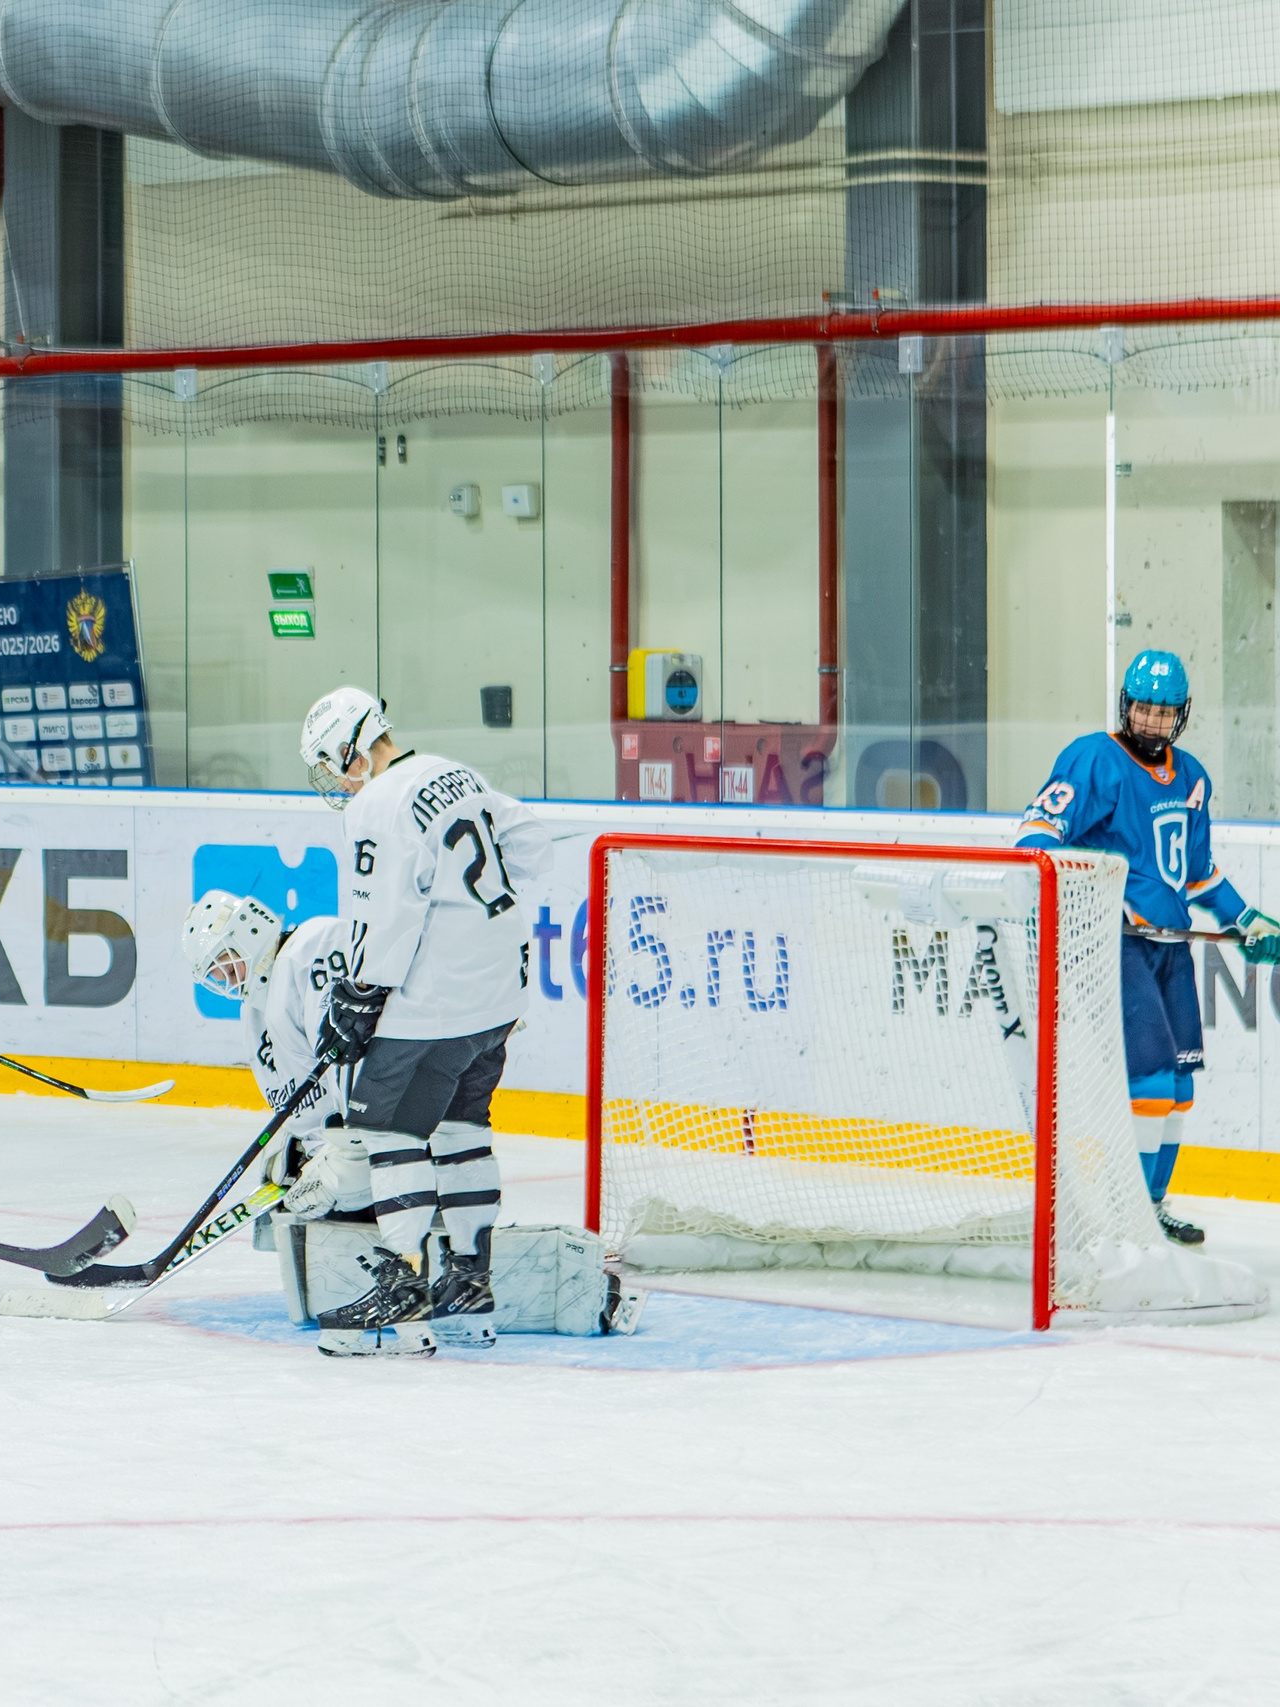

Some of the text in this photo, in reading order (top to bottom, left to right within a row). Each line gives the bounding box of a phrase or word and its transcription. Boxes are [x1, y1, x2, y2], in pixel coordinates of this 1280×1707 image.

[273, 612, 308, 627] ВЫХОД
[644, 766, 667, 795] ПК-43
[723, 770, 748, 799] ПК-44
